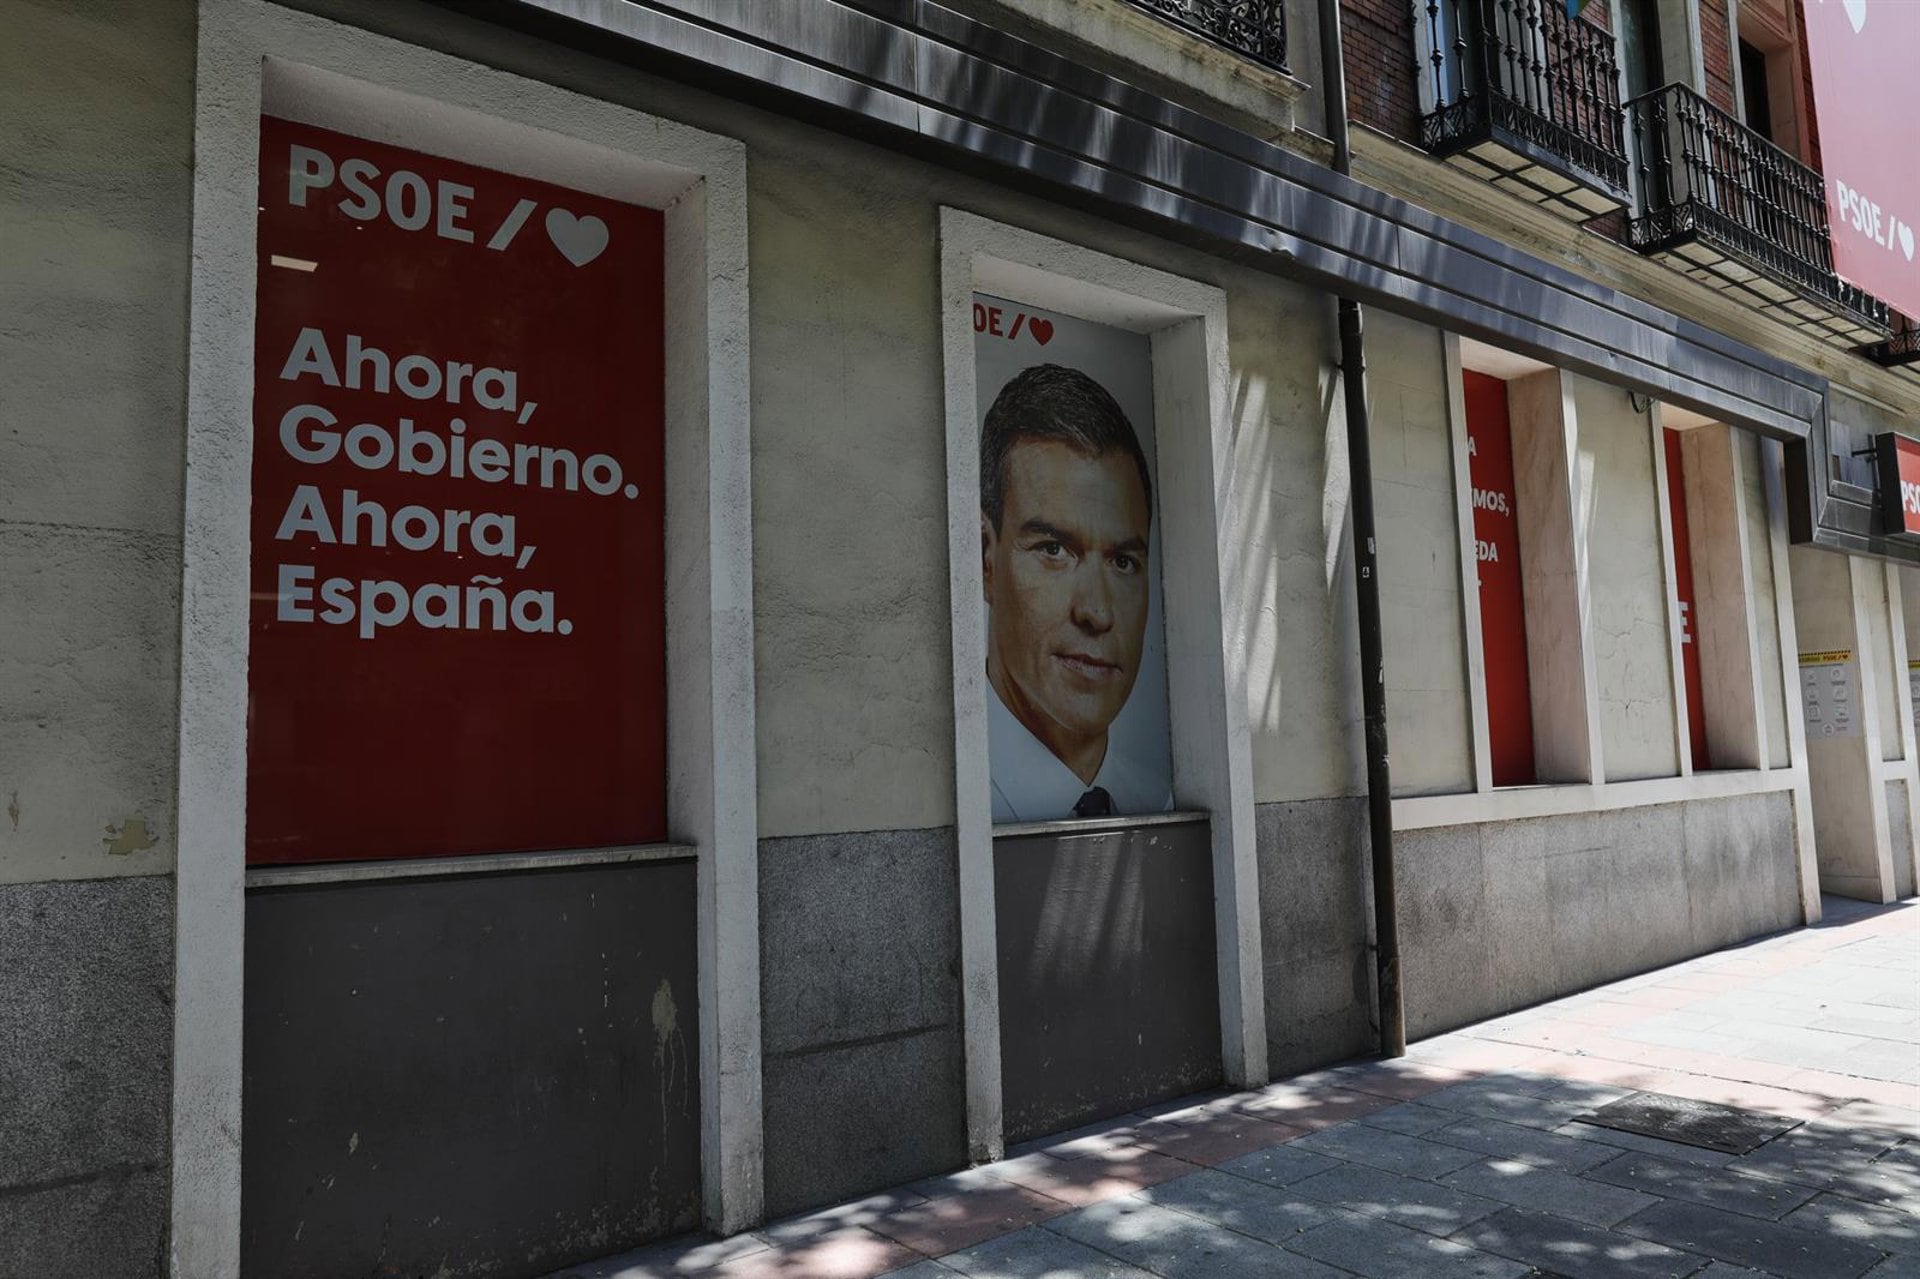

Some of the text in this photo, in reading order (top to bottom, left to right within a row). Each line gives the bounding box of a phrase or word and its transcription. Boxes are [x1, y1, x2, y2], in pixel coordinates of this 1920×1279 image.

[289, 144, 475, 244] PSOE
[1836, 179, 1885, 246] PSOE
[279, 327, 538, 425] Ahora,
[279, 404, 639, 499] Gobierno.
[275, 485, 537, 569] Ahora,
[1471, 488, 1509, 517] MOS,
[277, 563, 573, 639] España.
